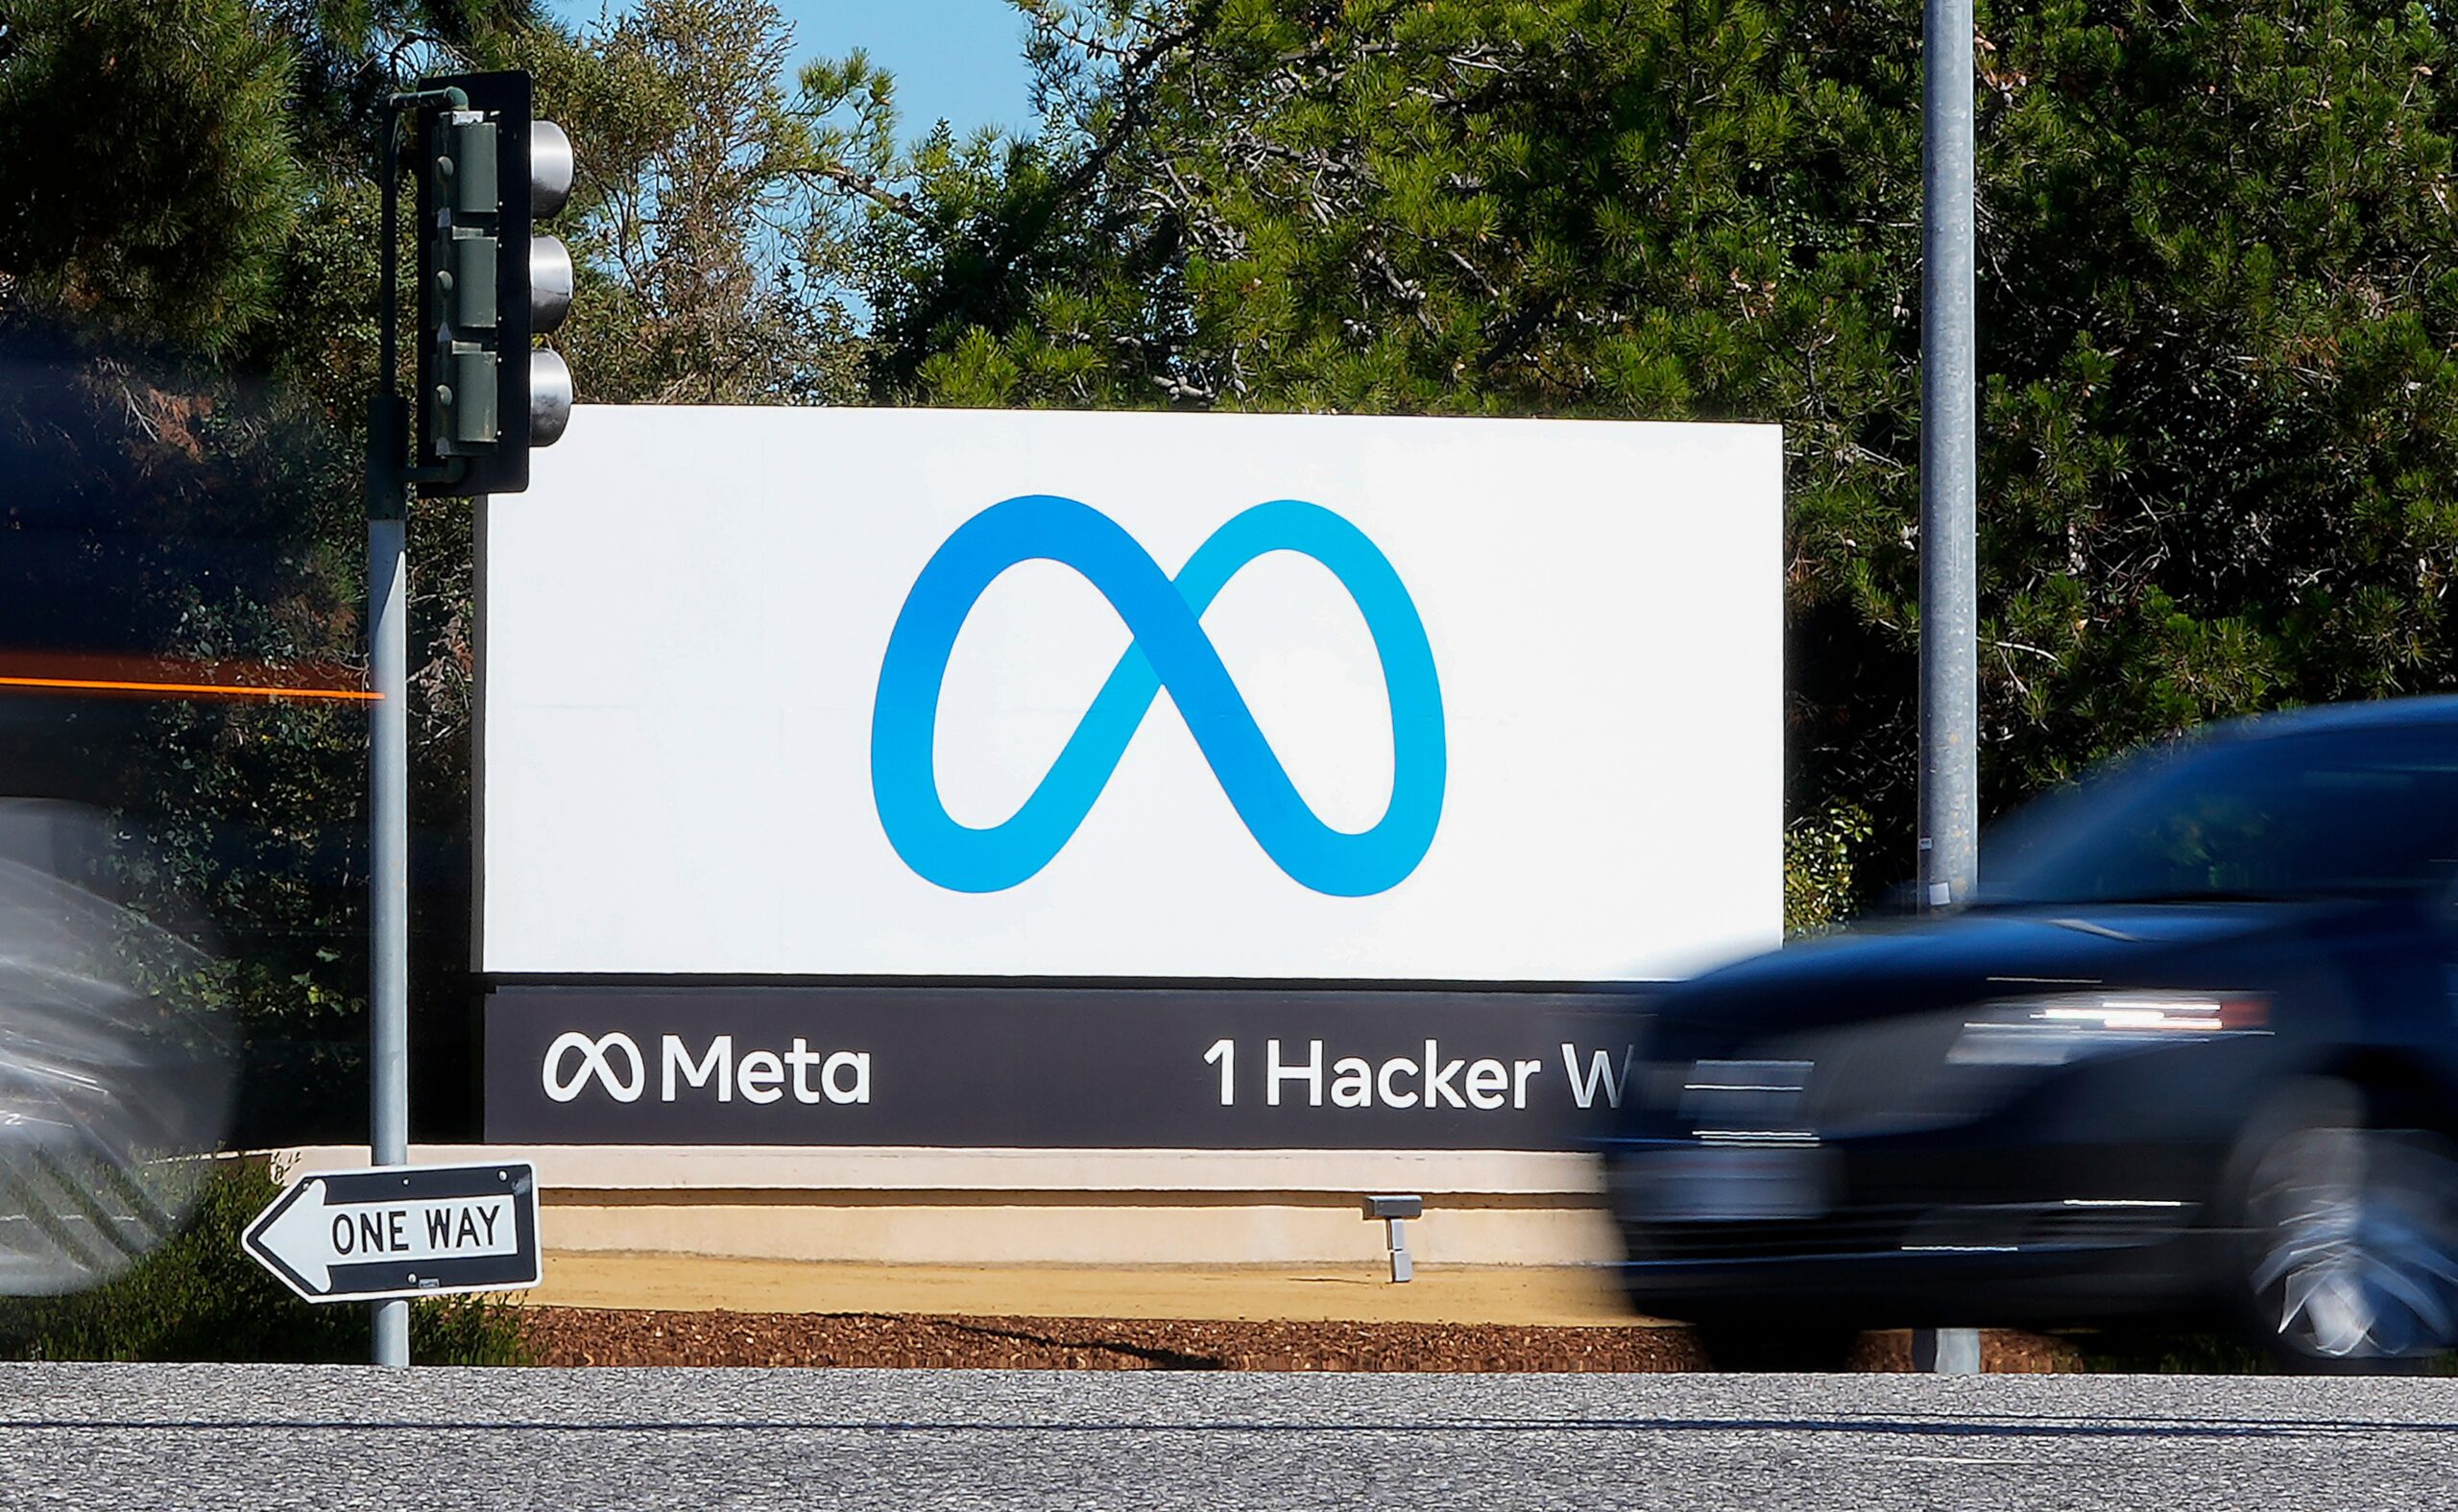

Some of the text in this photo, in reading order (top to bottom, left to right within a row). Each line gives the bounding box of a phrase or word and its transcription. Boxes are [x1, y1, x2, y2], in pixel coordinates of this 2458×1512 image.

[661, 1034, 870, 1104] Meta
[1202, 1038, 1235, 1106] 1
[1266, 1038, 1542, 1110] Hacker
[332, 1205, 500, 1256] ONE WAY
